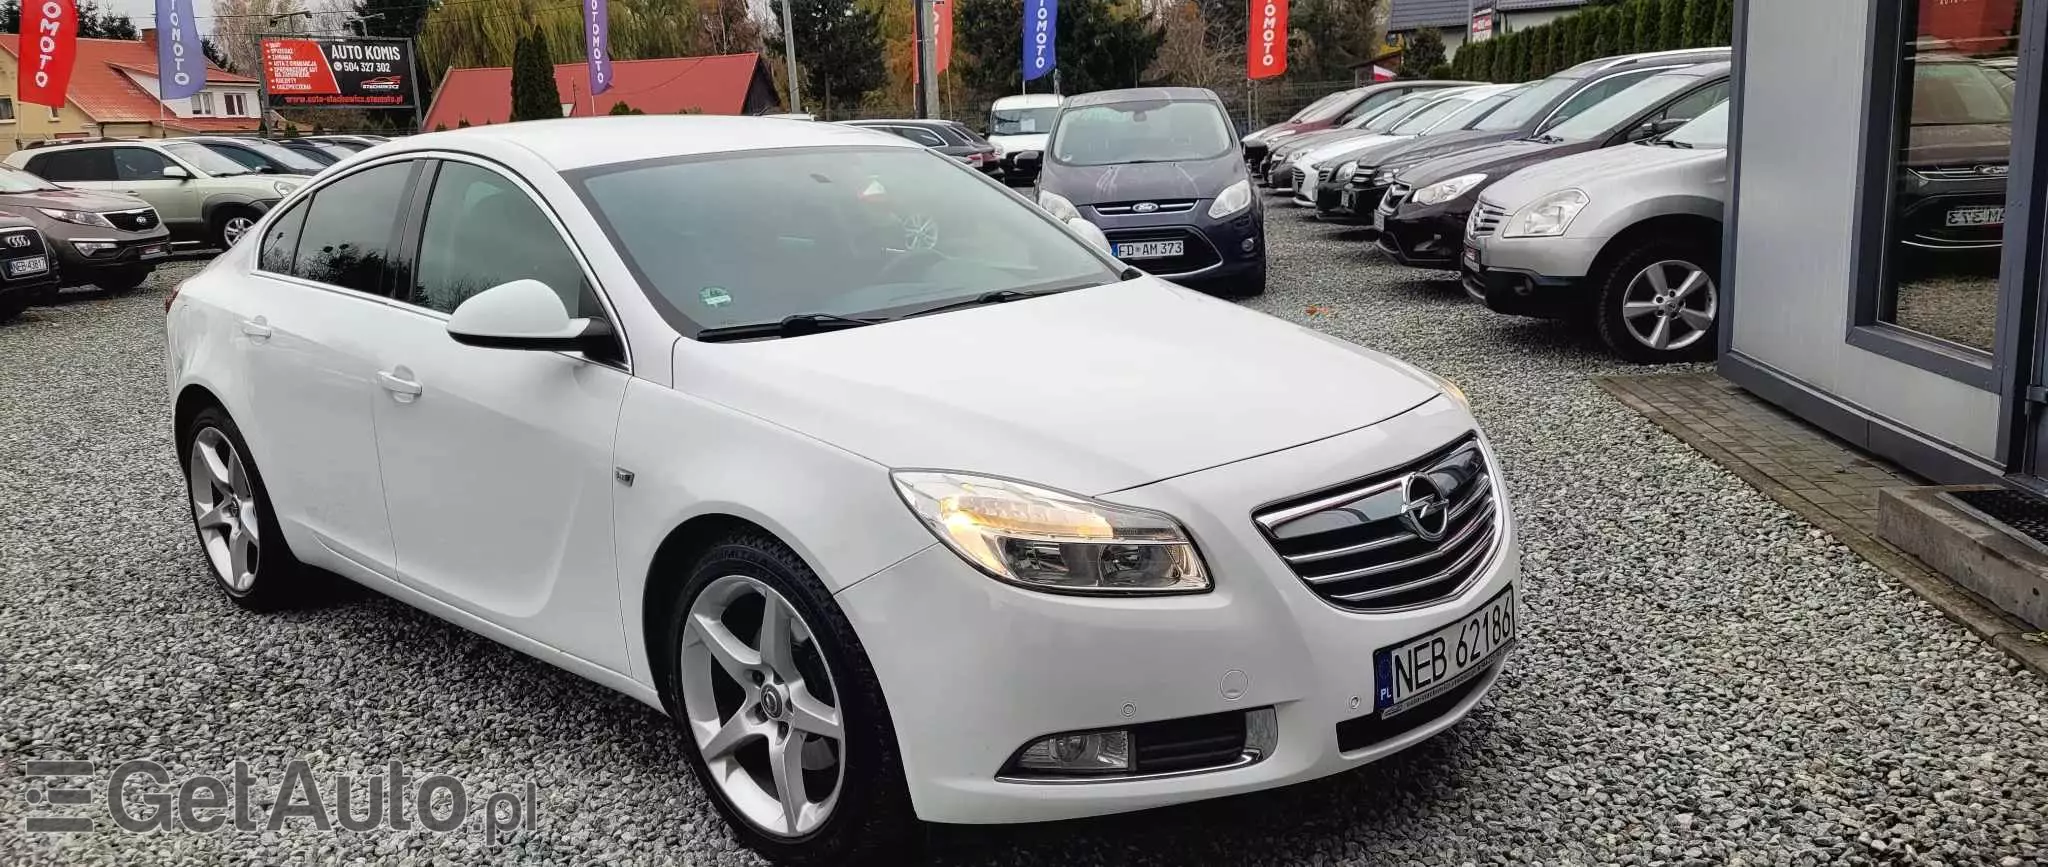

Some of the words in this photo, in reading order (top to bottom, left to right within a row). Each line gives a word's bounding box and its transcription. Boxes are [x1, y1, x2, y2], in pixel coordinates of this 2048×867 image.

[331, 44, 363, 60] AUTO
[364, 45, 401, 61] KOMIS
[343, 61, 360, 72] 504
[360, 62, 374, 72] 327
[375, 62, 392, 73] 302
[1118, 244, 1134, 257] FD
[1142, 243, 1158, 255] AM
[1160, 242, 1182, 255] 373
[1395, 636, 1447, 698] NEB
[1456, 597, 1511, 668] 62186
[1380, 688, 1392, 701] PL
